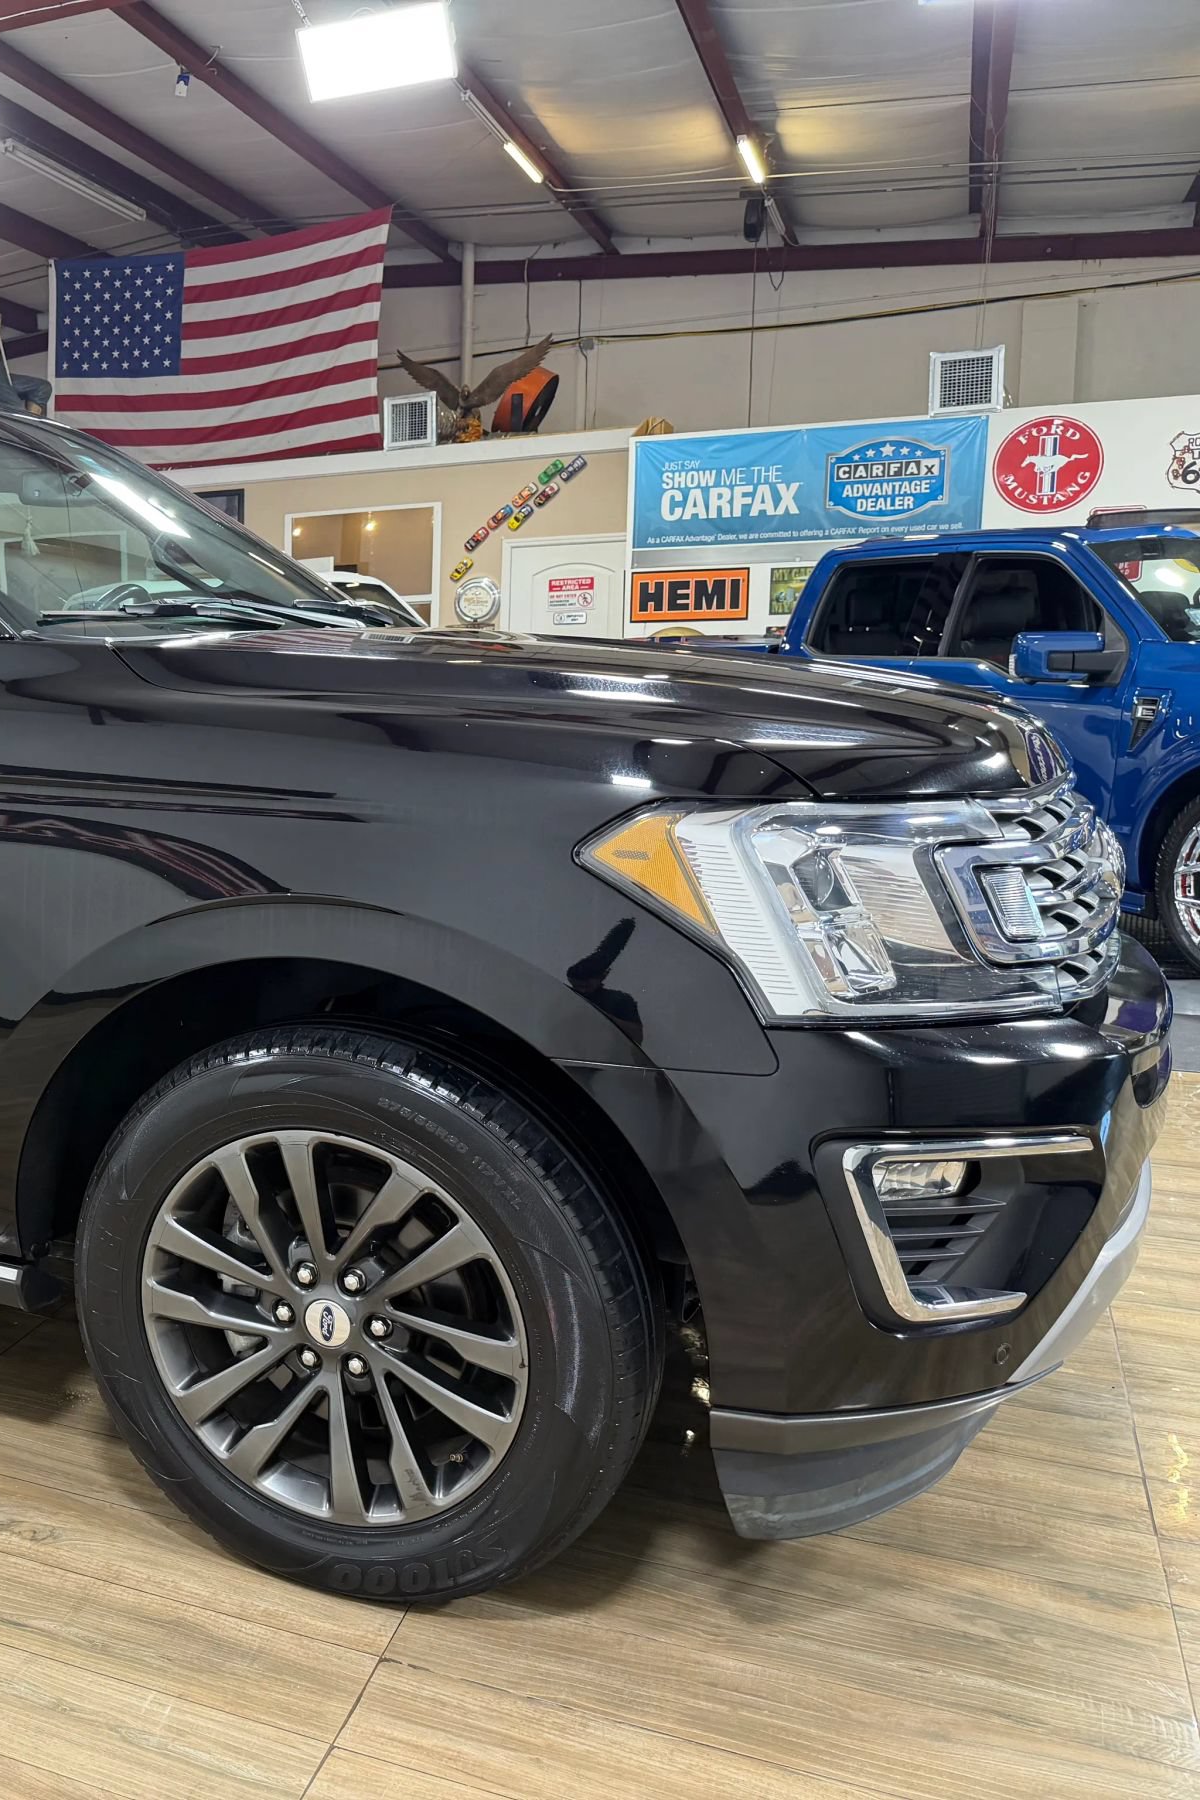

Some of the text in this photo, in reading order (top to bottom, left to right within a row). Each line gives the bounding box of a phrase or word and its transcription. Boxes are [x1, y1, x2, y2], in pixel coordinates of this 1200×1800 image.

[1016, 424, 1081, 445] FORD
[662, 460, 700, 471] JUST SAY
[837, 462, 937, 480] CARFAX
[662, 465, 783, 489] SHOW ME THE
[842, 480, 931, 497] ADVANTAGE
[1000, 471, 1091, 505] MUSTANG
[661, 482, 801, 521] CARFAX
[856, 497, 914, 512] DEALER
[661, 535, 685, 543] CARFAX
[760, 530, 791, 538] committed
[800, 529, 823, 537] offering
[830, 527, 856, 535] CARFAX
[858, 526, 880, 535] Report
[890, 525, 908, 533] every
[551, 578, 592, 586] RESTRICTED
[773, 569, 789, 581] MY
[638, 577, 742, 613] HEMI
[321, 1311, 333, 1337] Ford
